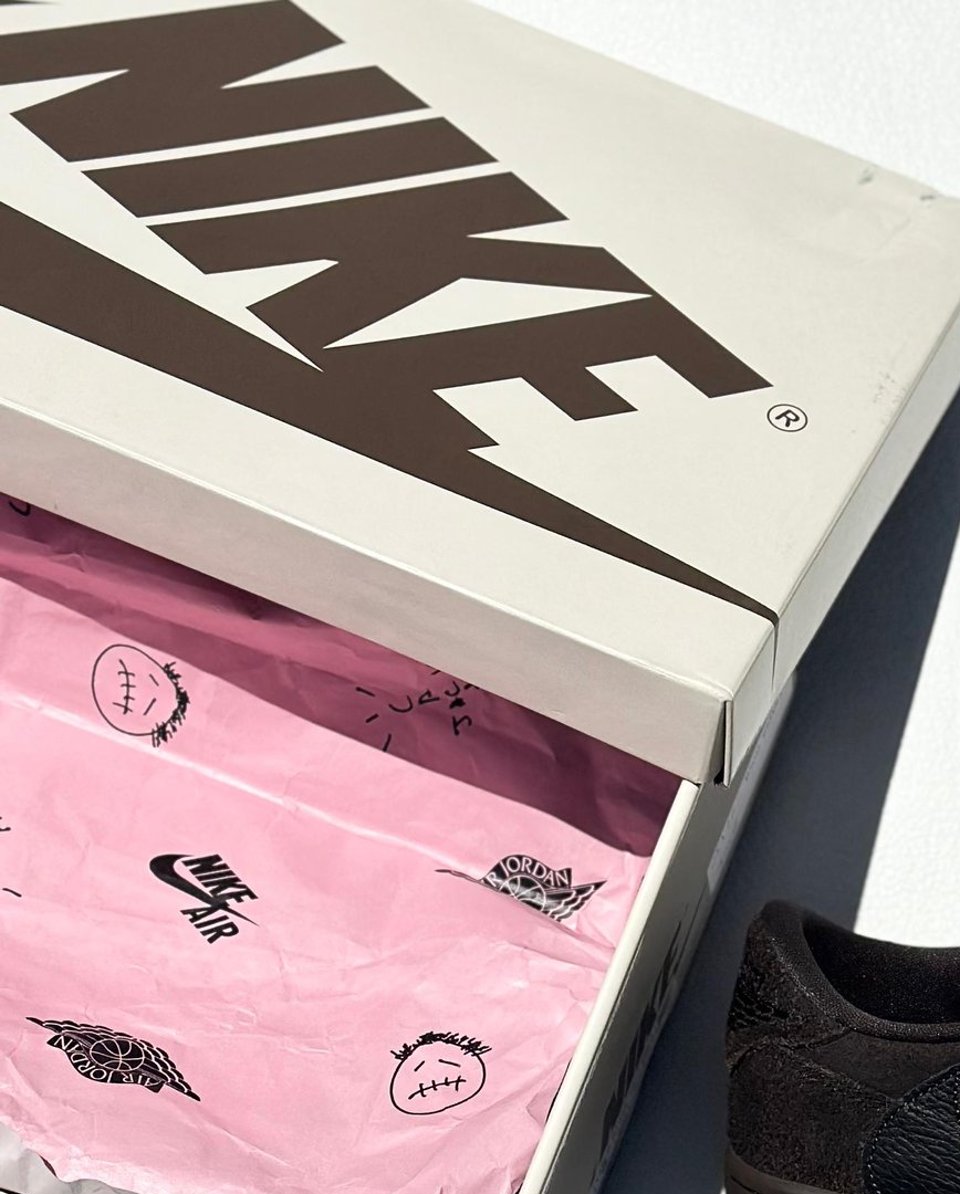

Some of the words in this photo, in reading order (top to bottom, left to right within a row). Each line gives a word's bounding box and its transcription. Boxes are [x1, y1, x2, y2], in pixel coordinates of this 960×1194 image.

[0, 0, 773, 449] NIKE
[181, 854, 259, 907] NIKE
[500, 856, 569, 886] JORDAN
[180, 906, 239, 944] AIR
